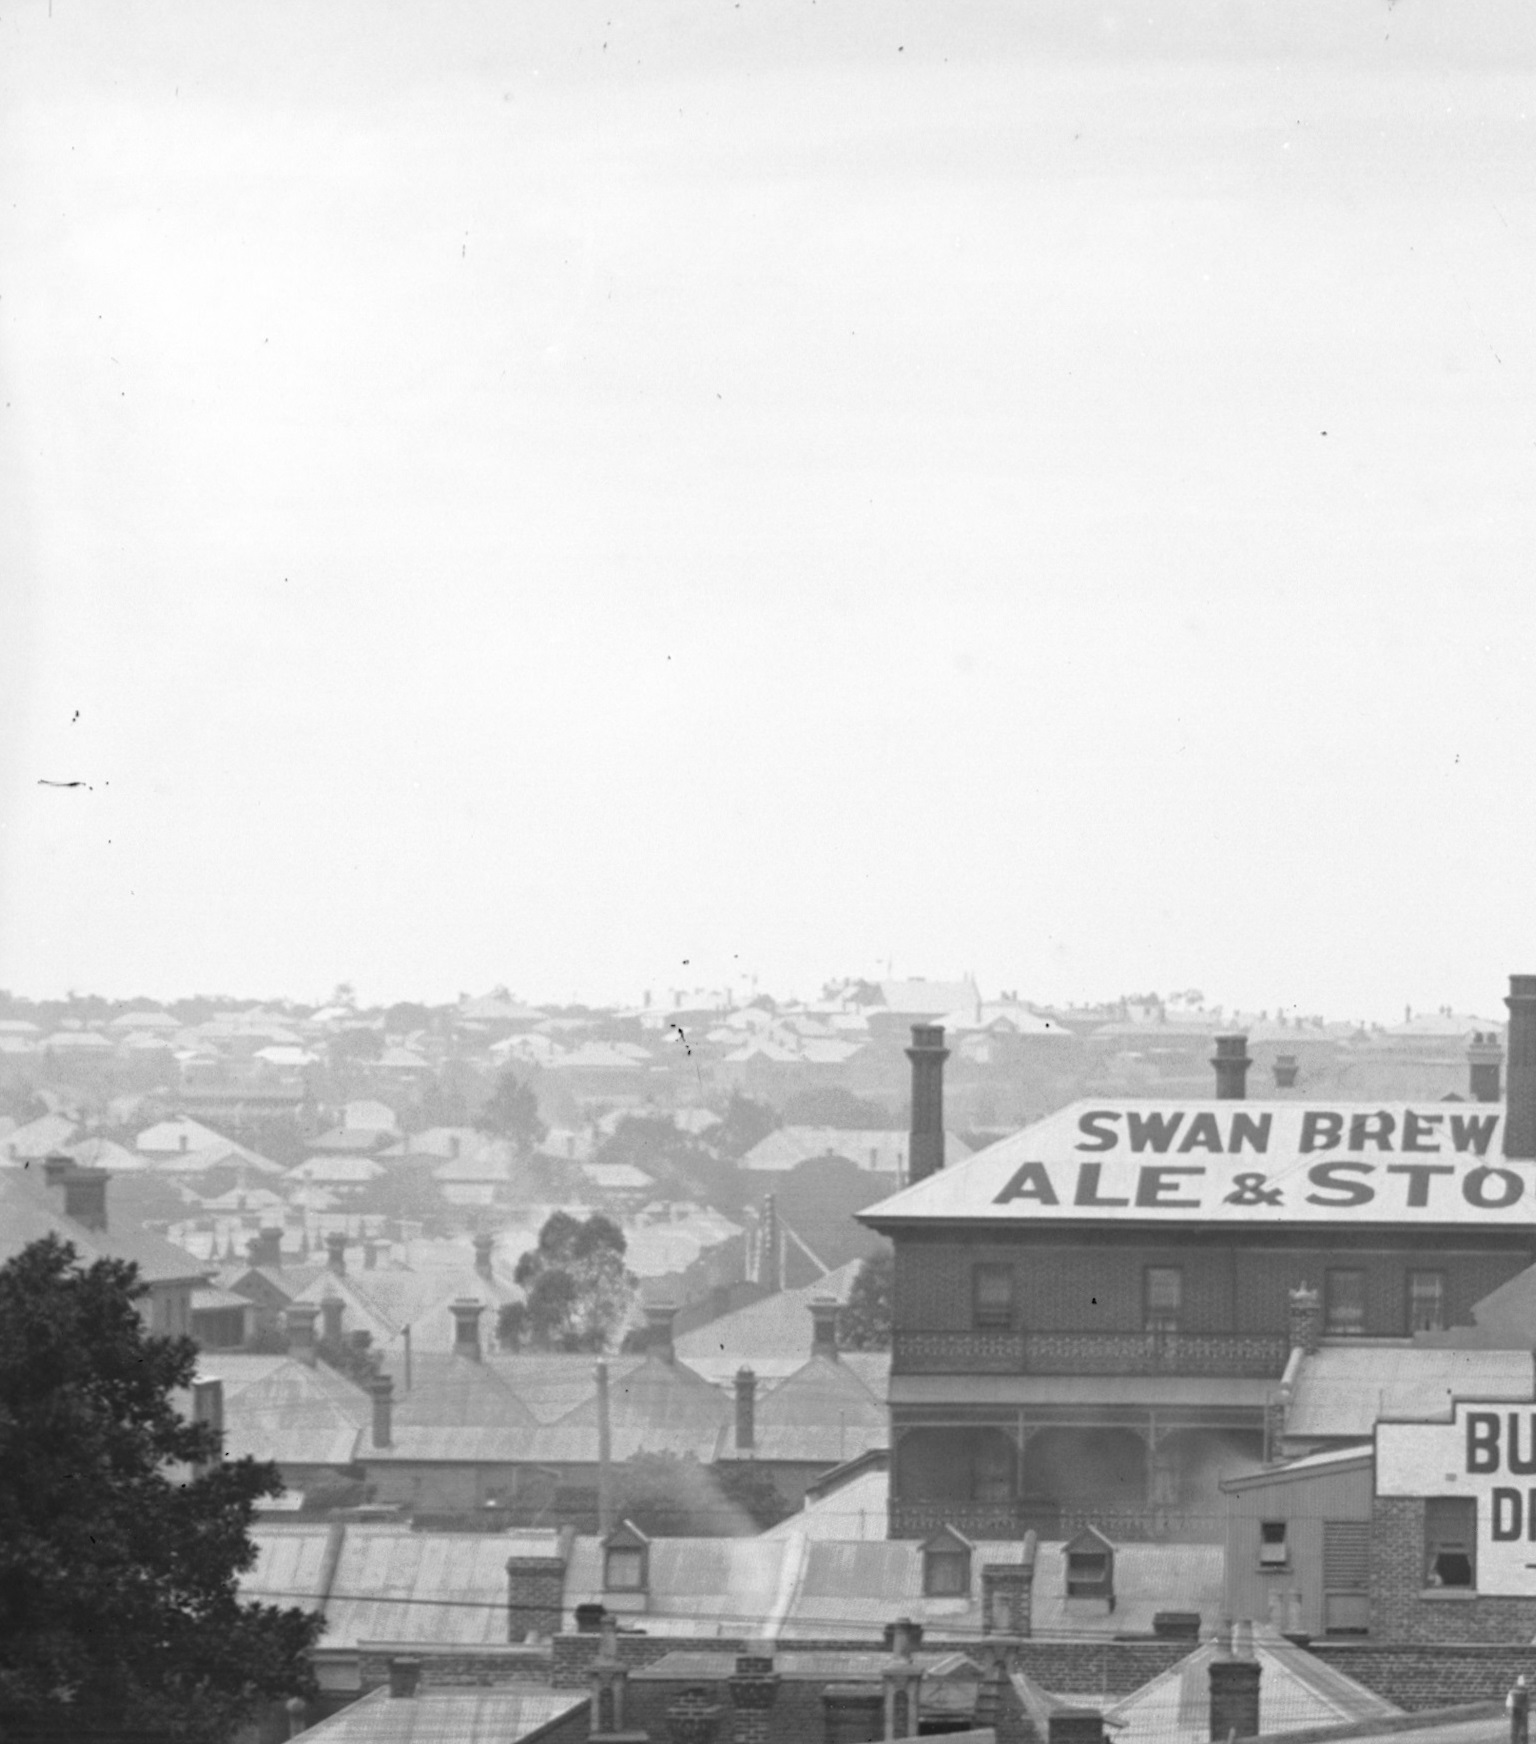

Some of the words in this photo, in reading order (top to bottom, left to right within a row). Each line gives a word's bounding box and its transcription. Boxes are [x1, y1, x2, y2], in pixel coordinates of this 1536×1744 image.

[1072, 1110, 1273, 1154] SWAN
[990, 1162, 1206, 1209] ALE
[1222, 1172, 1287, 1208] &
